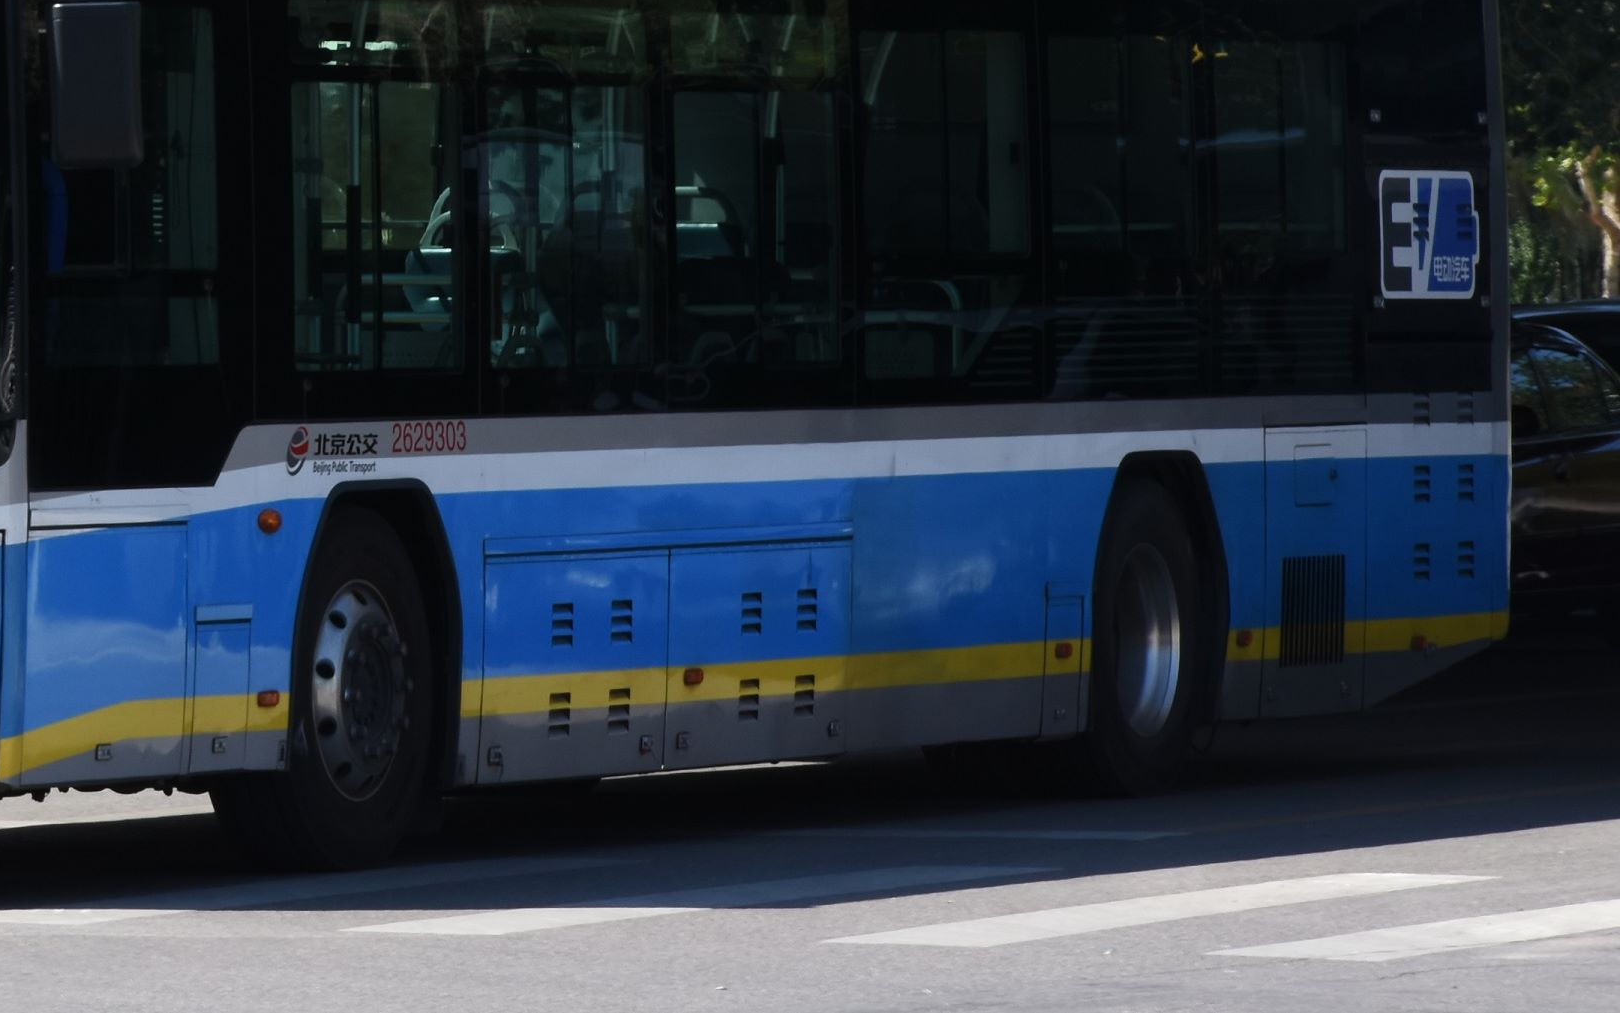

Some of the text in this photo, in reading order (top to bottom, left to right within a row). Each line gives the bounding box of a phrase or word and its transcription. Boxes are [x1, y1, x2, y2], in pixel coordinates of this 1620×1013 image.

[313, 434, 378, 456] 北京公交
[391, 421, 467, 453] 2629303
[313, 461, 376, 475] Beijing Public Transport
